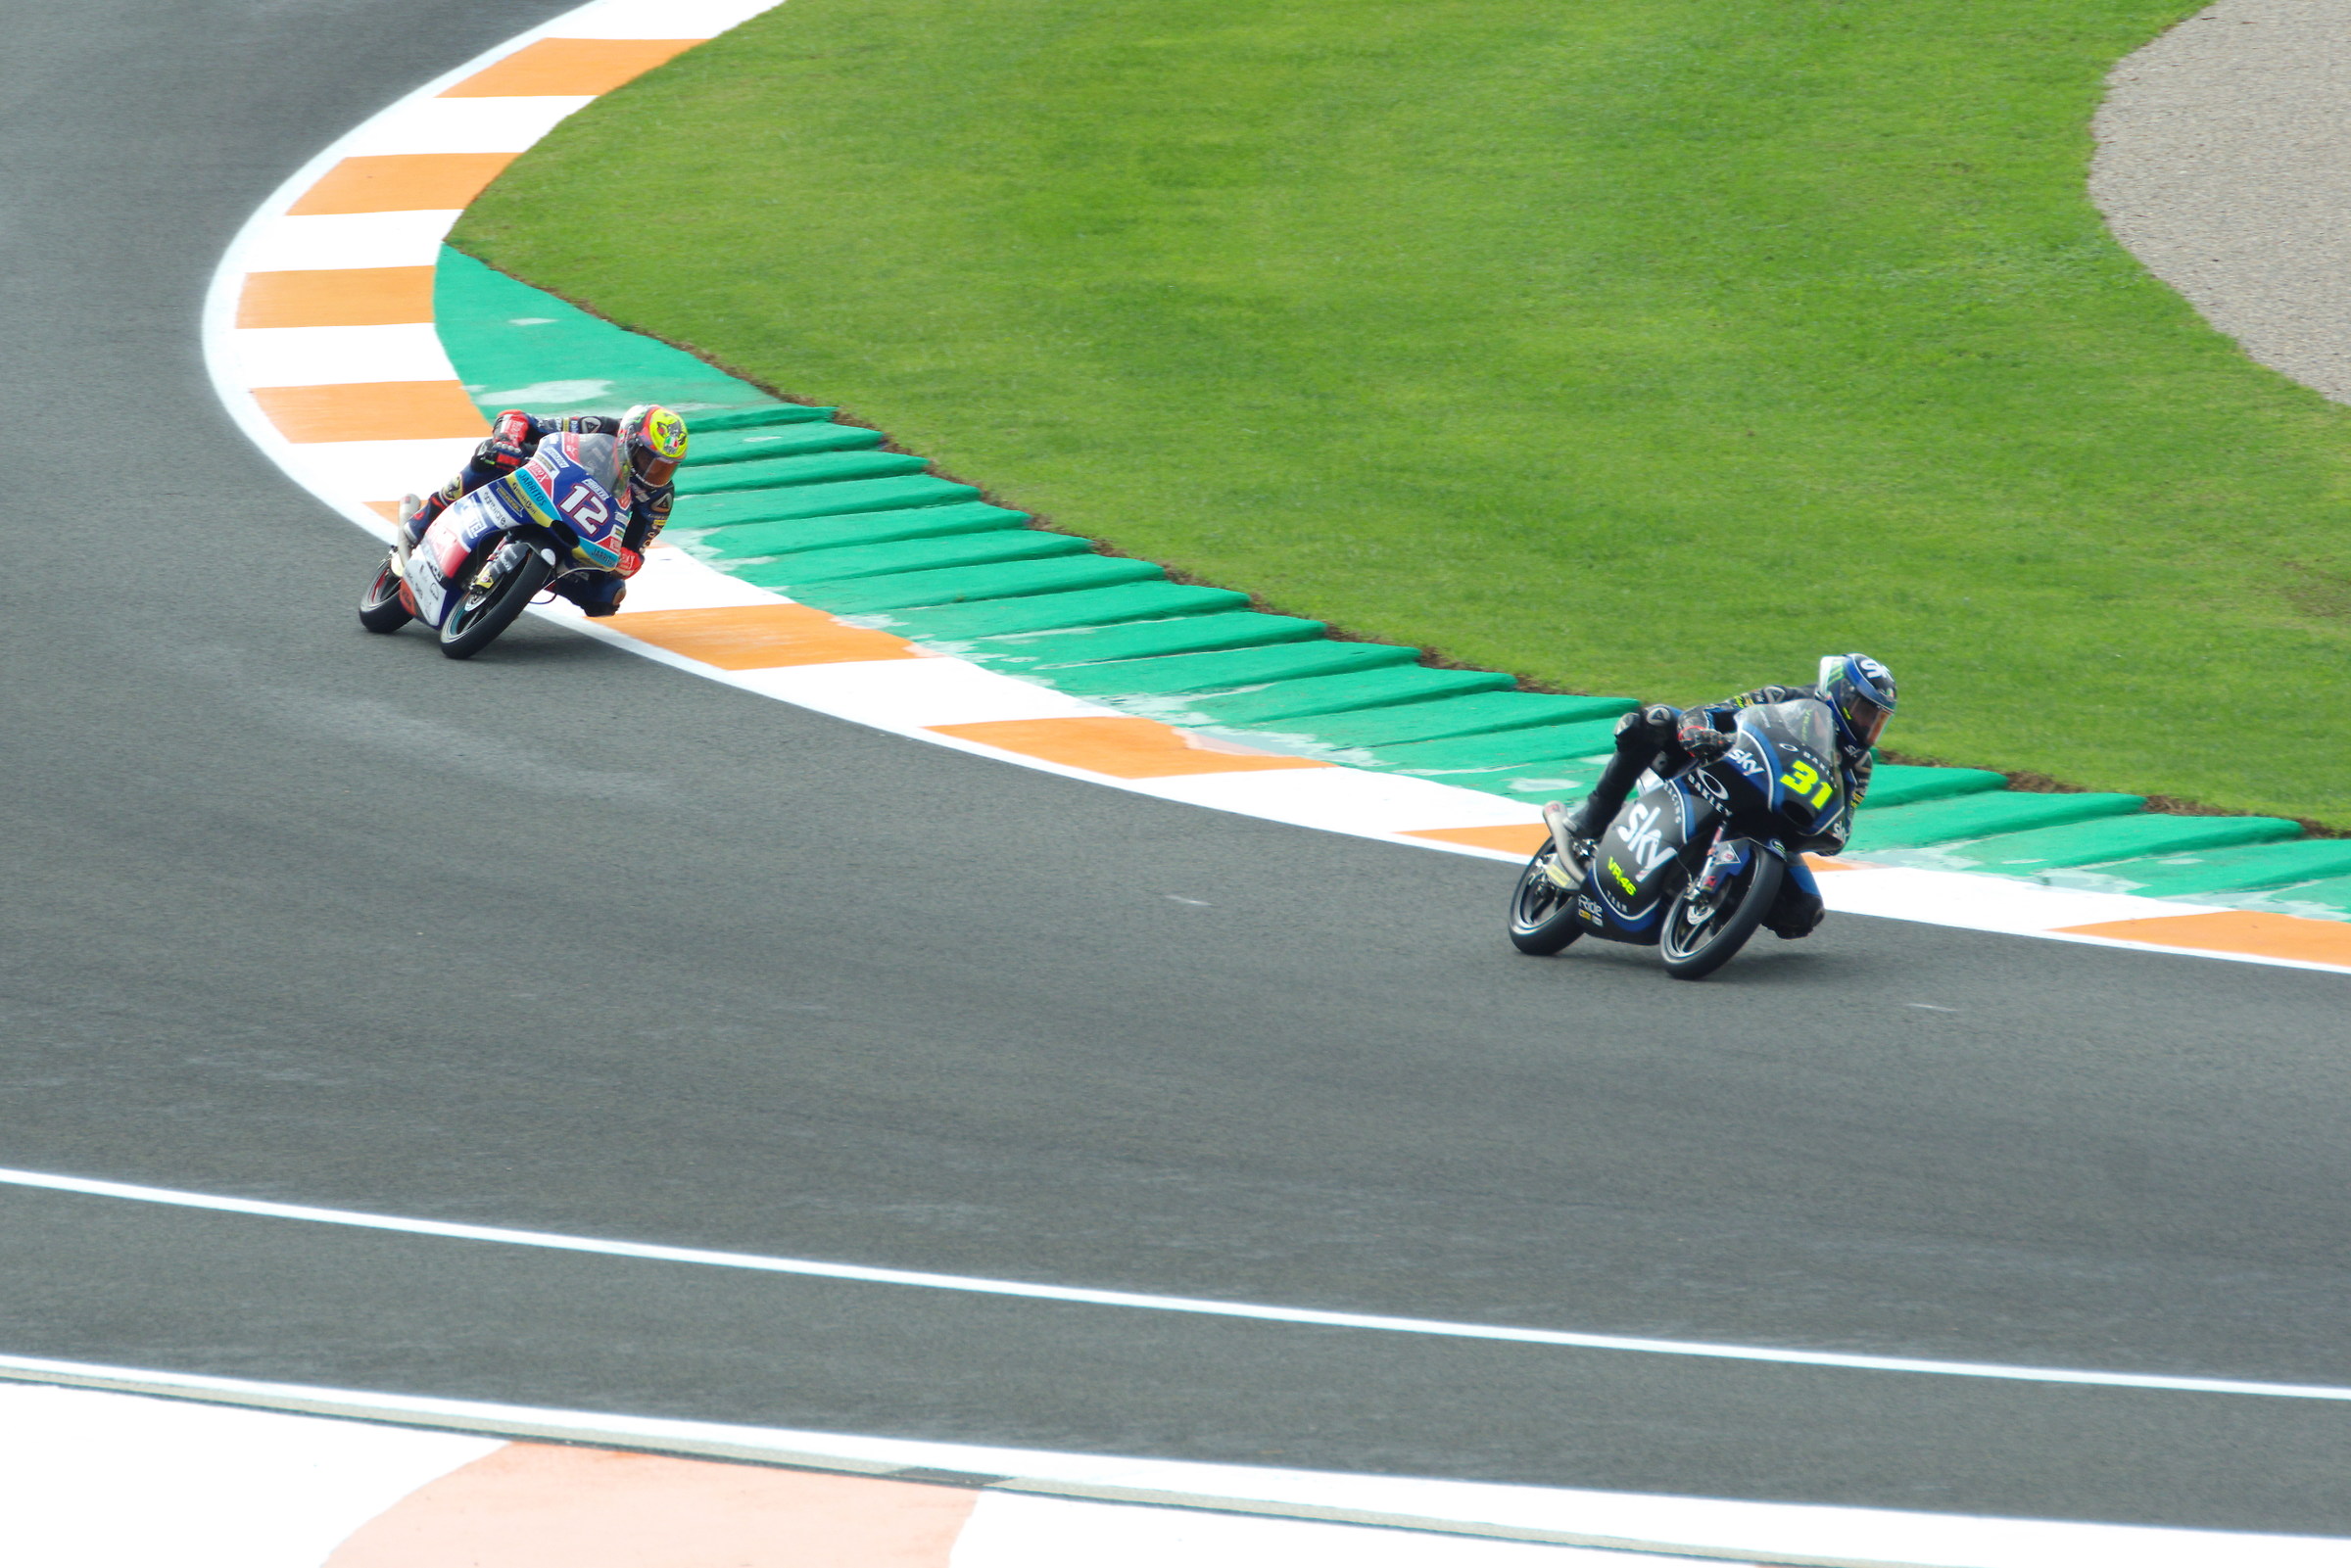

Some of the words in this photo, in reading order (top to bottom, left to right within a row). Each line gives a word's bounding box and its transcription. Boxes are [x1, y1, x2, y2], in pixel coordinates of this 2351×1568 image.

[519, 473, 548, 506] JARRITOS
[559, 484, 608, 536] 12
[1728, 749, 1765, 777] sky
[1780, 760, 1834, 809] 31
[1688, 774, 1733, 817] OAKLEY
[1617, 803, 1678, 881] sky
